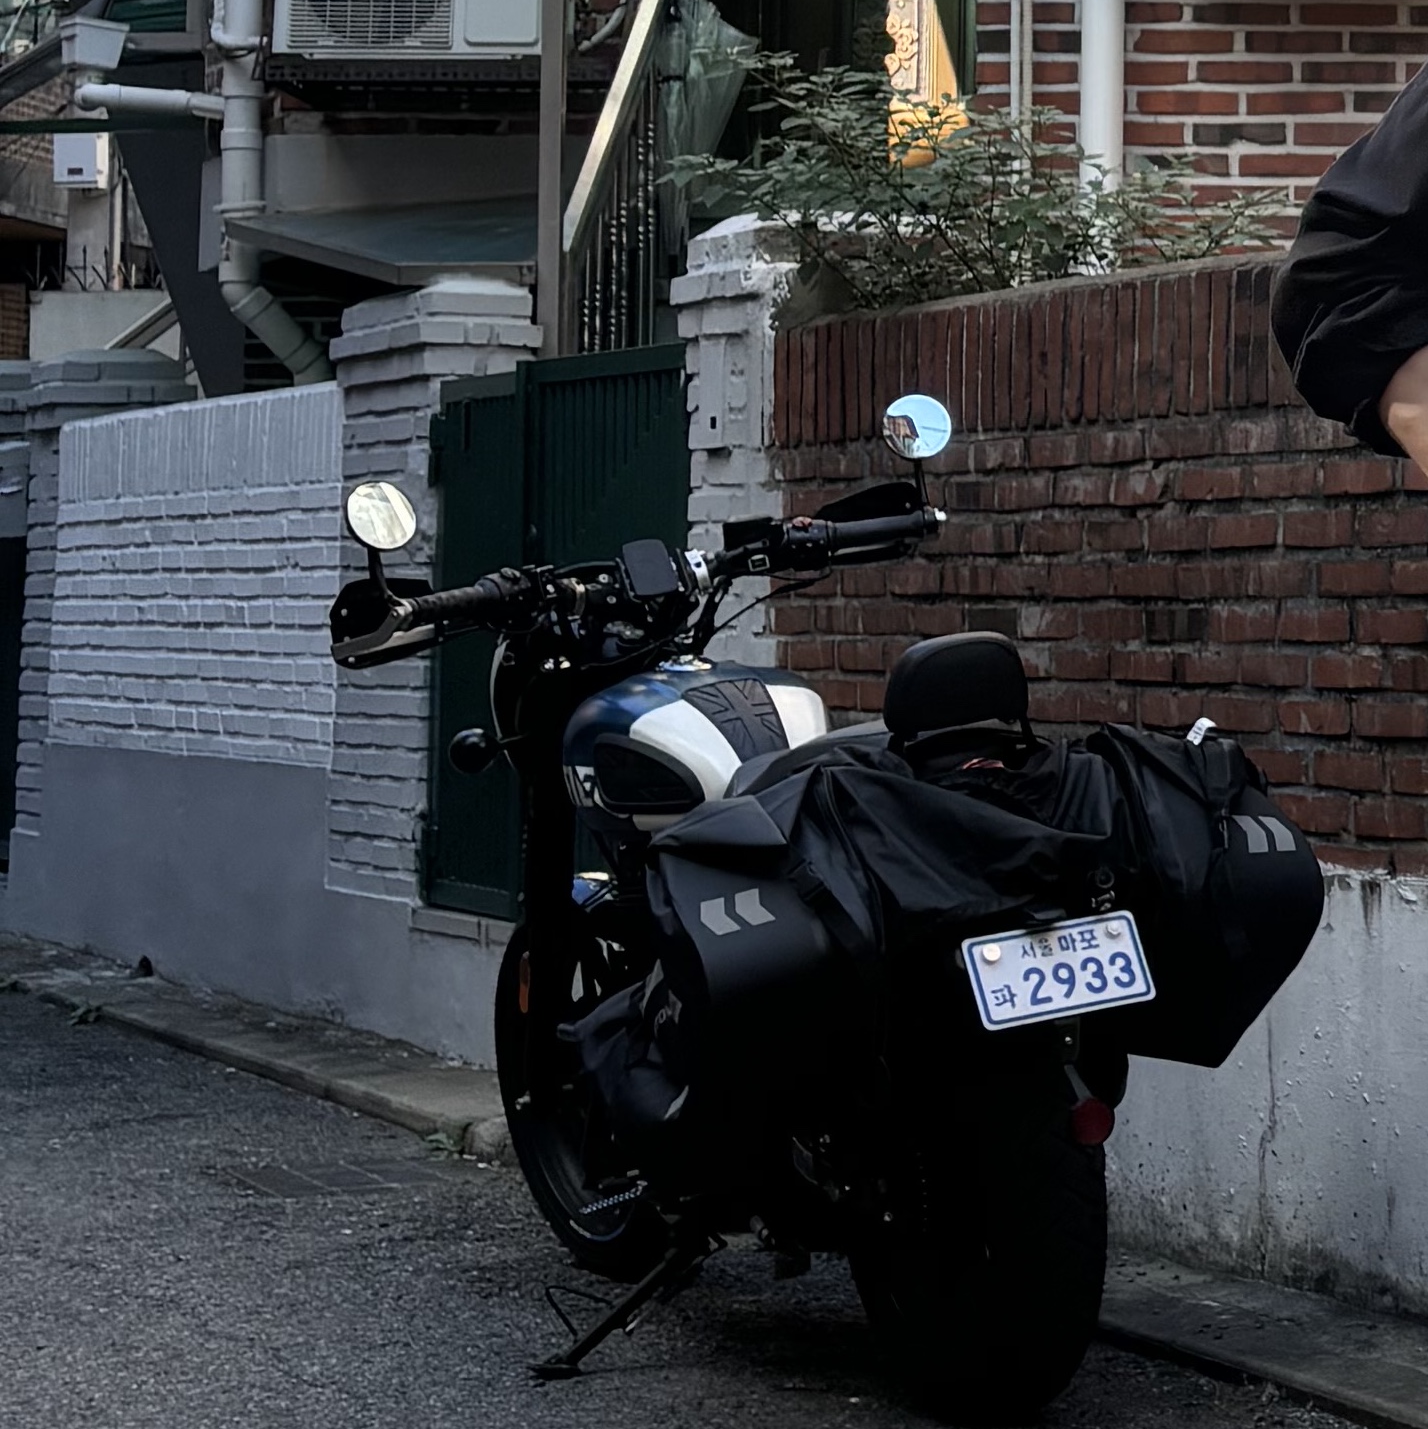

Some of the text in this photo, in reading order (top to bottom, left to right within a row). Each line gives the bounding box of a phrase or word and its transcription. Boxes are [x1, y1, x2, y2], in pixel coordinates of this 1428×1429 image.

[1021, 928, 1100, 959] 서울 마포
[990, 951, 1136, 1009] 파 2933
